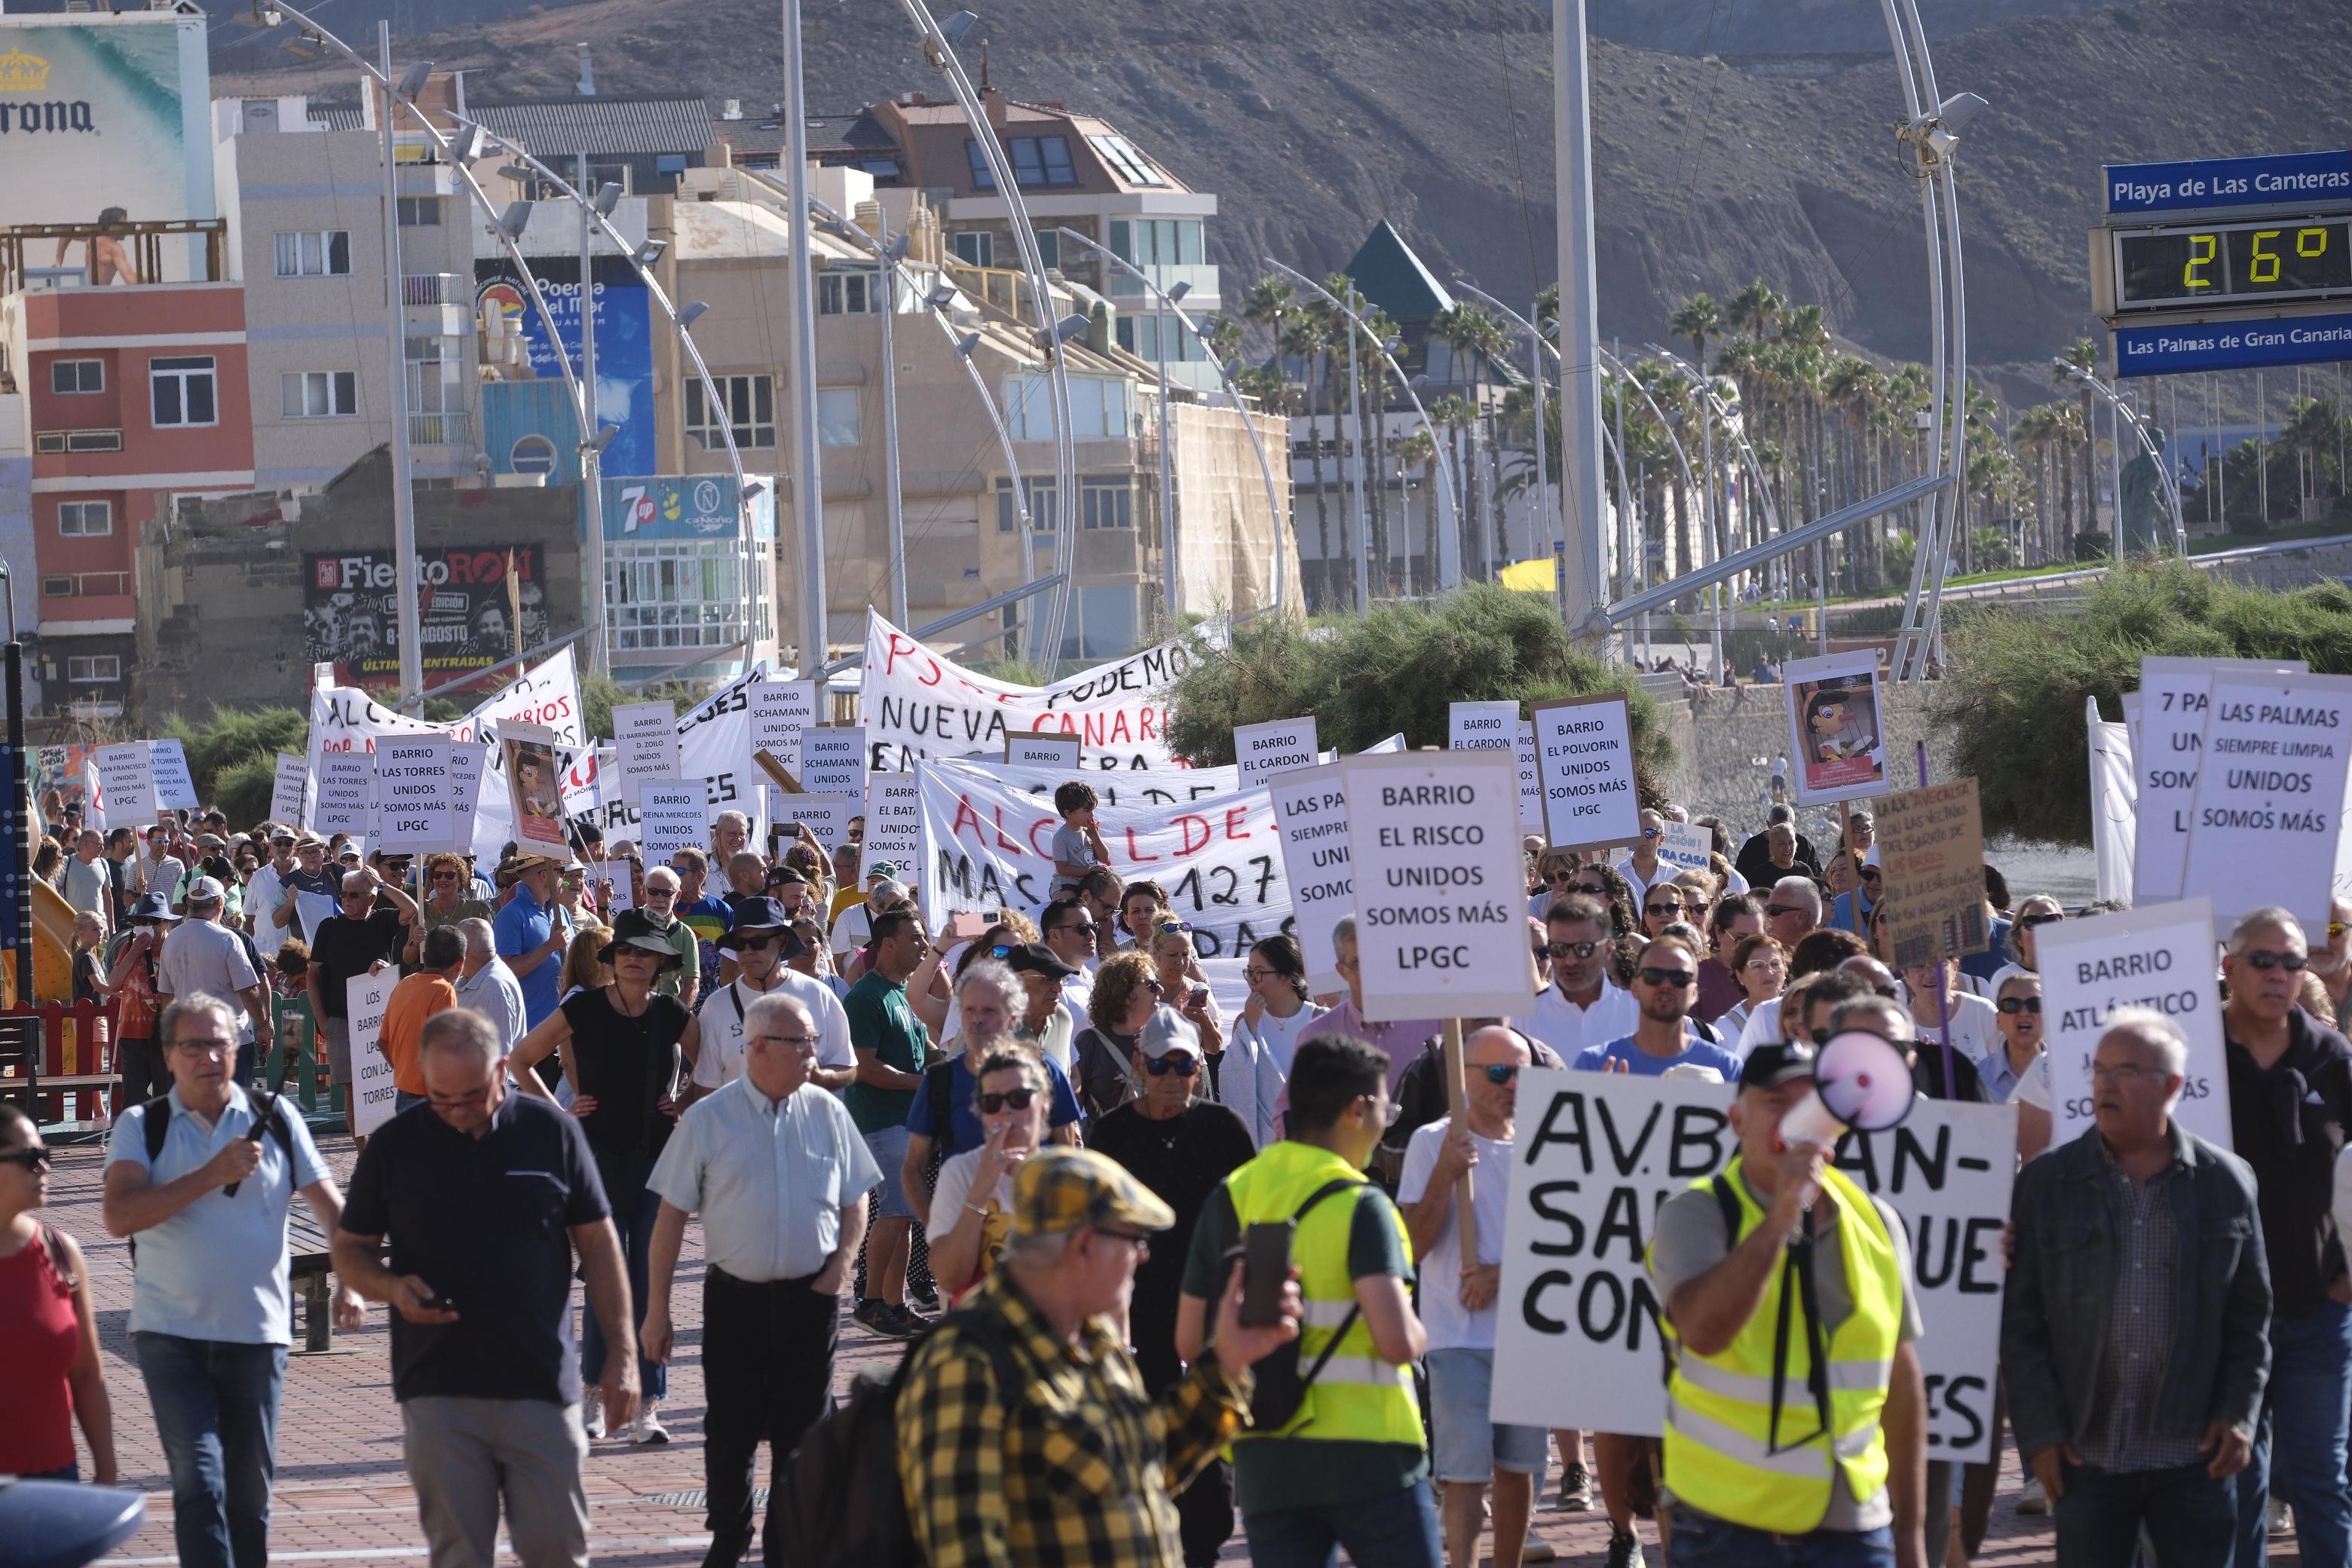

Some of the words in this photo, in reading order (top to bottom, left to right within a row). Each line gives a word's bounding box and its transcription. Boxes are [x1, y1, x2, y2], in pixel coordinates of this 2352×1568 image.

[2115, 182, 2171, 205] Playa
[2179, 179, 2206, 198] de
[2213, 176, 2248, 195] Las
[2255, 172, 2350, 192] Canteras
[2127, 340, 2154, 356] Las
[2159, 336, 2215, 354] Palmas
[2219, 335, 2240, 349] de
[2245, 330, 2285, 348] Gran
[2290, 326, 2352, 345] Canaria
[421, 626, 469, 643] AGOSTO
[362, 657, 400, 672] ÚLTIM
[423, 656, 495, 669] ENTRADAS
[1047, 646, 1189, 710] PODEMO
[764, 692, 799, 702] BARRIO
[2162, 693, 2174, 712] 7
[754, 708, 810, 718] SCHAMANN
[2220, 702, 2255, 722] LAS
[2261, 704, 2339, 728] PALMAS
[634, 718, 662, 727] BARRIO
[881, 696, 1006, 742] NUEVA
[1031, 706, 1170, 747] CANARI
[1463, 718, 1502, 730] BARRIO
[764, 724, 801, 733] UNIDOS
[1557, 721, 1604, 736] BARRIO
[626, 730, 671, 739] BARRANQUILLO
[755, 740, 788, 748] SOMOS
[815, 743, 850, 752] BARRIO
[1253, 735, 1297, 750] BARRIO
[1455, 740, 1465, 750] EL
[1468, 738, 1511, 749] CARDON
[2215, 738, 2279, 755] SIEMPRE
[2283, 742, 2334, 758] LIMPIA
[392, 749, 433, 759] BARRIO
[1548, 747, 1560, 757] EL
[1563, 740, 1619, 755] POLVORIN
[109, 753, 136, 761] BARRIO
[633, 752, 661, 761] UNIDOS
[1024, 751, 1060, 761] BARRIO
[804, 758, 859, 768] SCHAMANN
[1244, 761, 1257, 771] EL
[1259, 753, 1310, 769] CARDON
[100, 764, 112, 773] SAN
[113, 763, 147, 772] FRANCISCO
[286, 764, 306, 773] BARRI
[382, 767, 401, 777] LAS
[404, 766, 446, 777] TORRES
[626, 765, 653, 774] SOMOS
[654, 763, 670, 771] MÁS
[1561, 761, 1610, 776] UNIDOS
[814, 774, 850, 784] UNIDOS
[2227, 769, 2312, 792] UNIDOS
[106, 785, 130, 793] SOMOS
[283, 784, 302, 793] UNID
[394, 785, 436, 795] UNIDOS
[847, 790, 859, 798] ÁS
[886, 788, 914, 798] BARR
[1521, 786, 1540, 797] MÁS
[1549, 784, 1596, 799] SOMOS
[1599, 778, 1628, 793] MÁS
[276, 793, 299, 803] SOMOS
[653, 795, 691, 804] BARRIO
[1382, 783, 1475, 807] BARRIO
[115, 796, 138, 806] LPGC
[348, 801, 365, 810] MÁS
[384, 803, 421, 813] SOMOS
[424, 800, 447, 811] MÁS
[1285, 797, 1318, 816] LAS
[792, 810, 831, 819] BARRIO
[879, 806, 890, 815] EL
[1573, 804, 1601, 816] LPGC
[1877, 804, 1889, 817] LA
[327, 815, 351, 823] LPGC
[2202, 807, 2274, 829] SOMOS
[2280, 808, 2326, 832] MÁS
[397, 820, 430, 831] LPGC
[654, 825, 693, 834] UNIDOS
[880, 824, 917, 834] UNIDO
[1671, 823, 1685, 833] LA
[1882, 820, 1901, 838] CON
[1380, 826, 1407, 847] EL
[1412, 825, 1485, 846] RISCO
[1882, 840, 1905, 855] DEL
[1905, 830, 1947, 852] BARRIO
[1950, 823, 1967, 839] DE
[647, 842, 679, 850] SOMOS
[682, 841, 703, 850] MÁS
[868, 841, 906, 850] SOMOS
[1679, 852, 1708, 867] CASA
[1386, 865, 1484, 888] UNIDOS
[1173, 855, 1277, 911] 127
[1367, 905, 1452, 926] SOMOS
[1458, 900, 1508, 924] MÁS
[1398, 945, 1471, 969] LPGC
[2077, 948, 2172, 985] BARRIO
[366, 990, 380, 1005] LOS
[361, 1067, 378, 1080] CON
[363, 1086, 394, 1105] TORRES
